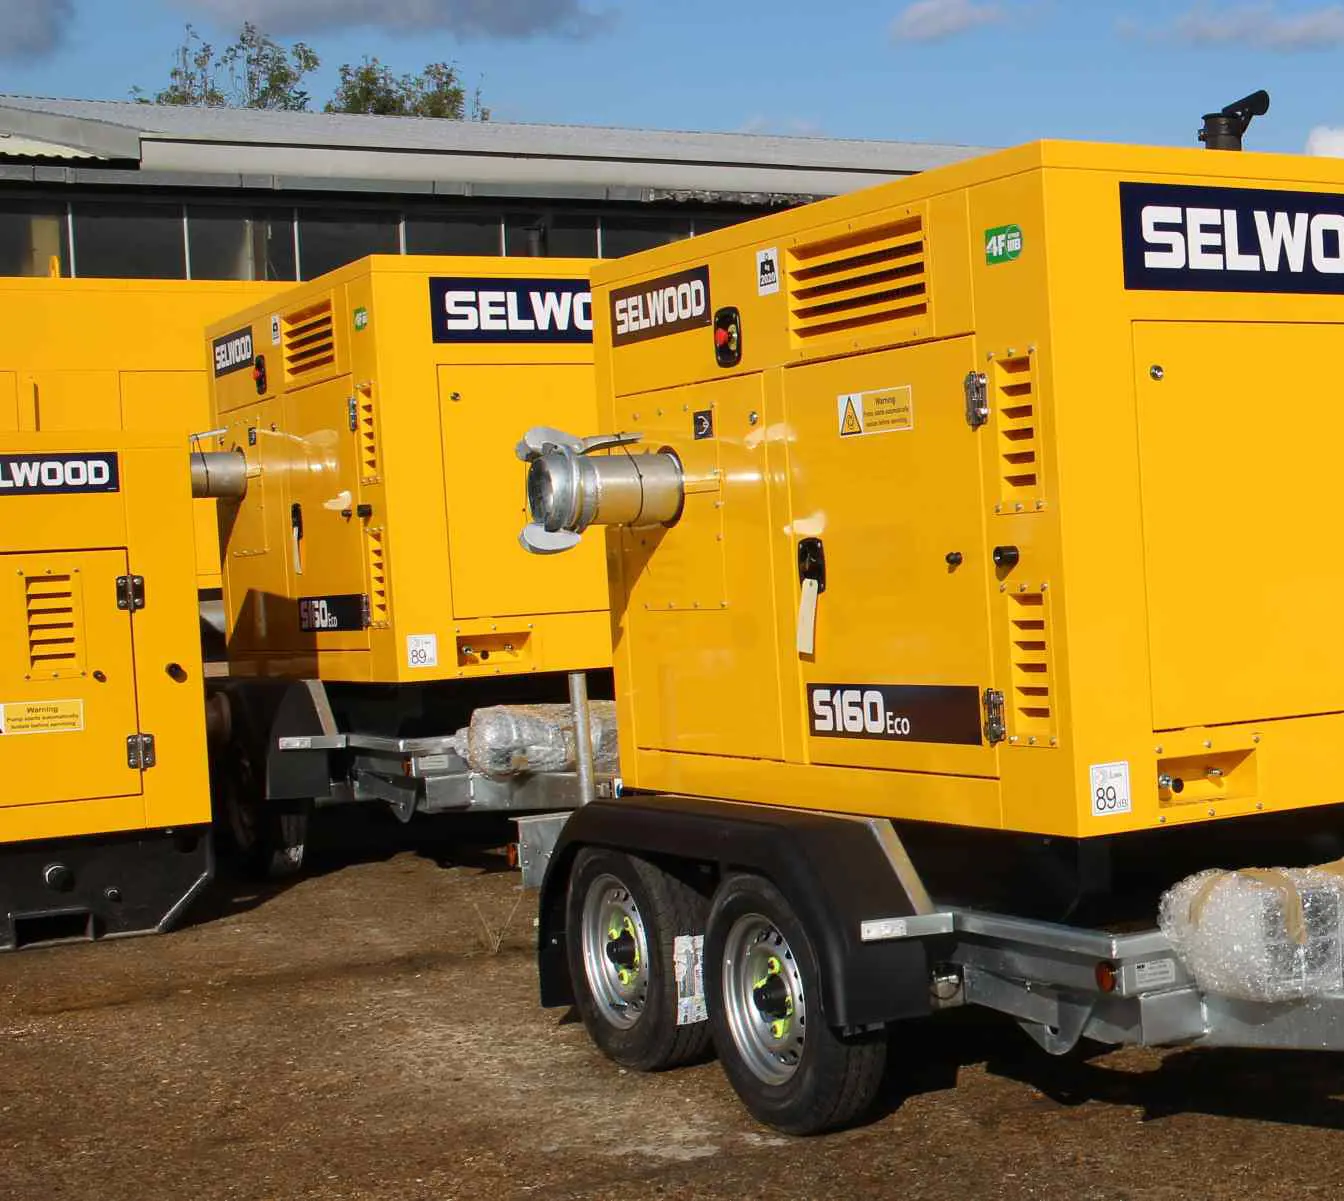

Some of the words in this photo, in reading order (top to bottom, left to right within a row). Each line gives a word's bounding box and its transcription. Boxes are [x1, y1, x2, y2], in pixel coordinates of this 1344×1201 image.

[445, 290, 592, 331] SELWO
[616, 279, 706, 335] SELWOOD
[215, 334, 252, 370] SELWOOD
[0, 460, 110, 488] LWOOD
[411, 649, 427, 665] 89
[813, 689, 885, 733] S160
[886, 711, 910, 735] Eco
[1096, 786, 1117, 810] 89
